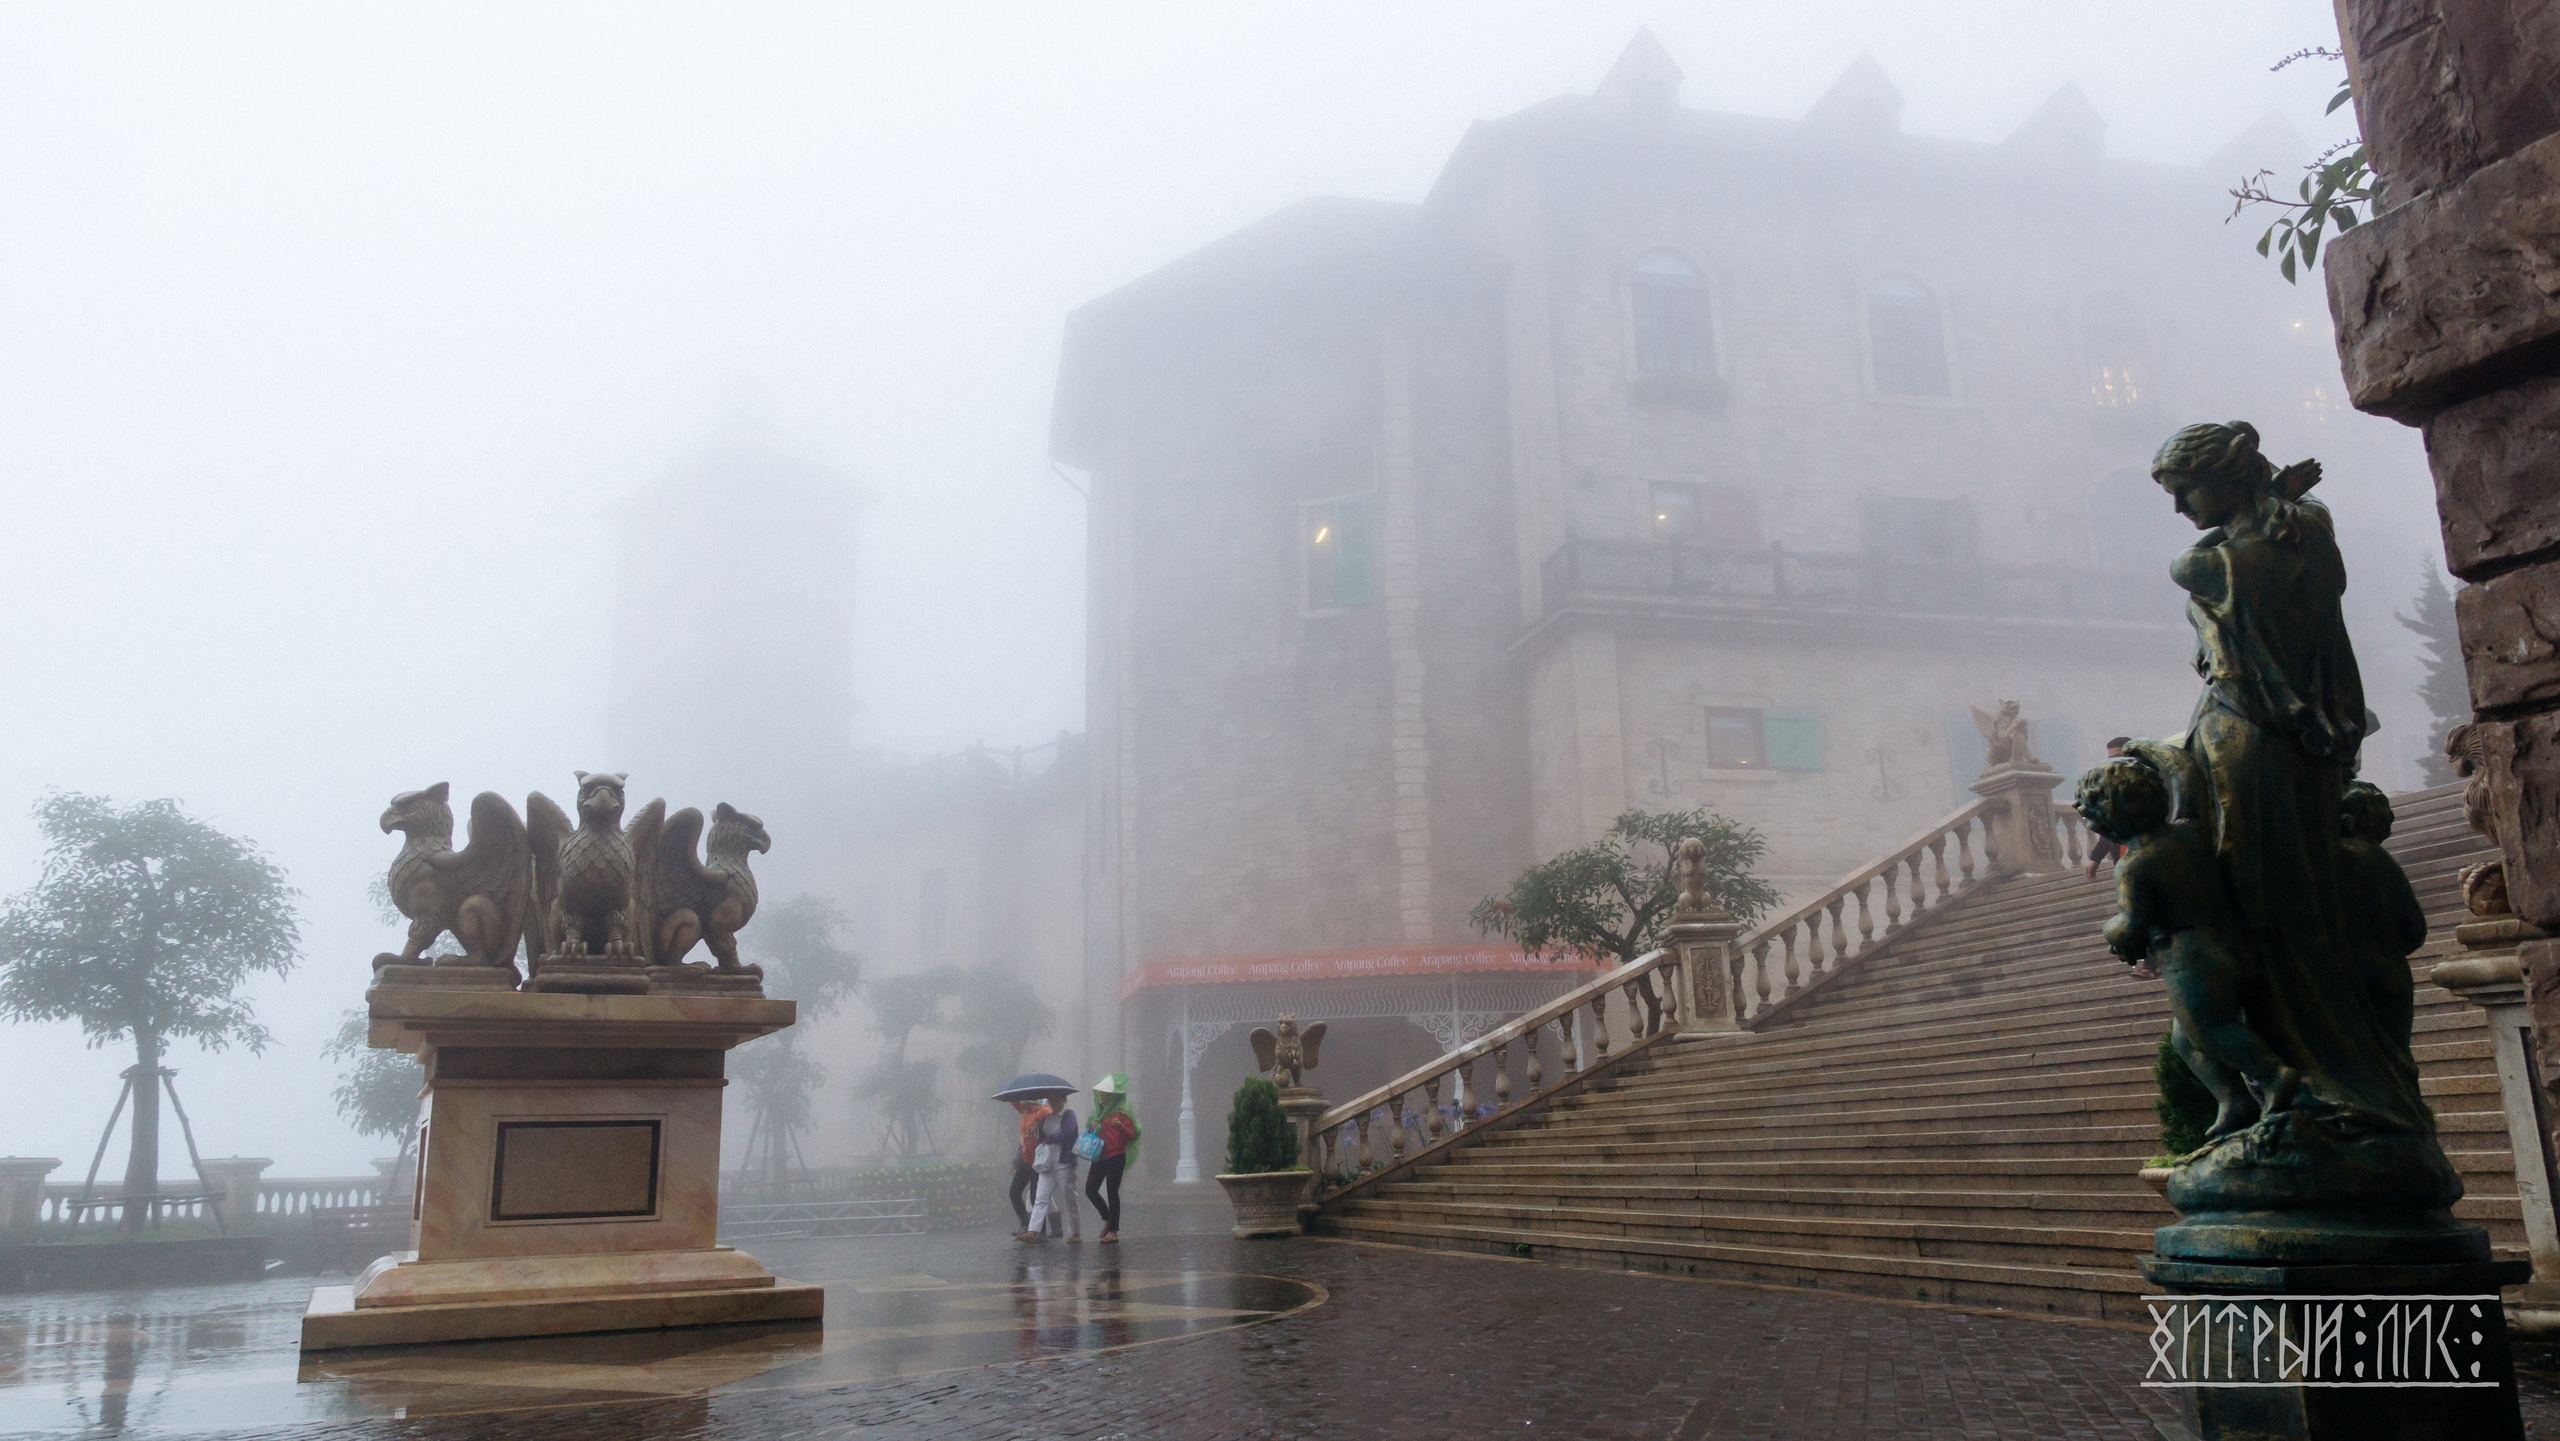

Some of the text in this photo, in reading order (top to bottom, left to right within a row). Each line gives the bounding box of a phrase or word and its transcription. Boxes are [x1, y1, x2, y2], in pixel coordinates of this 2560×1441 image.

[1168, 966, 1205, 979] Arapang
[1208, 963, 1238, 976] Coffee
[1250, 963, 1289, 975] Arapang
[1291, 960, 1322, 972] Coffee
[1333, 958, 1374, 972] Arapang
[1377, 955, 1409, 968] Coffee
[1420, 954, 1462, 968] Arapang
[1465, 952, 1498, 965] Coffee
